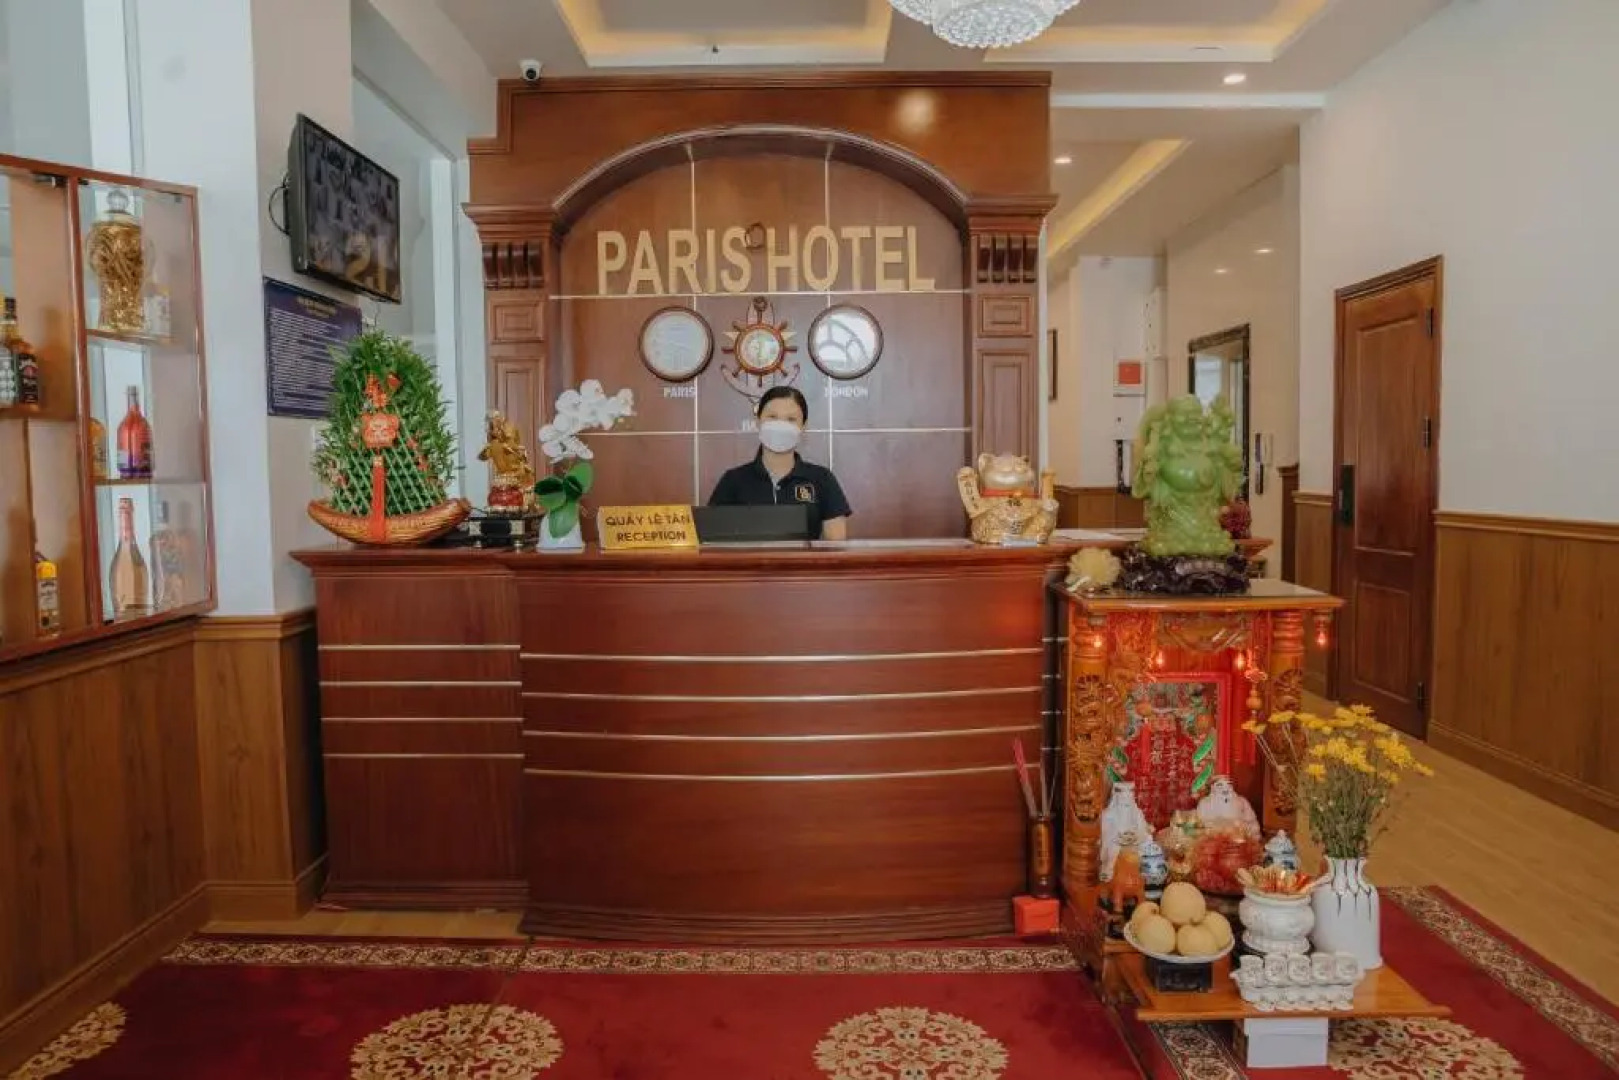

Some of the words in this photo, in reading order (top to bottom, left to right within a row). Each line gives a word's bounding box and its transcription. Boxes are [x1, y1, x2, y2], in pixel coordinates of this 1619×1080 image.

[597, 226, 751, 295] PARIS
[766, 225, 936, 292] HOTEL
[663, 386, 696, 398] PARIS
[824, 385, 868, 398] LONDON
[616, 530, 687, 542] RECEPTION
